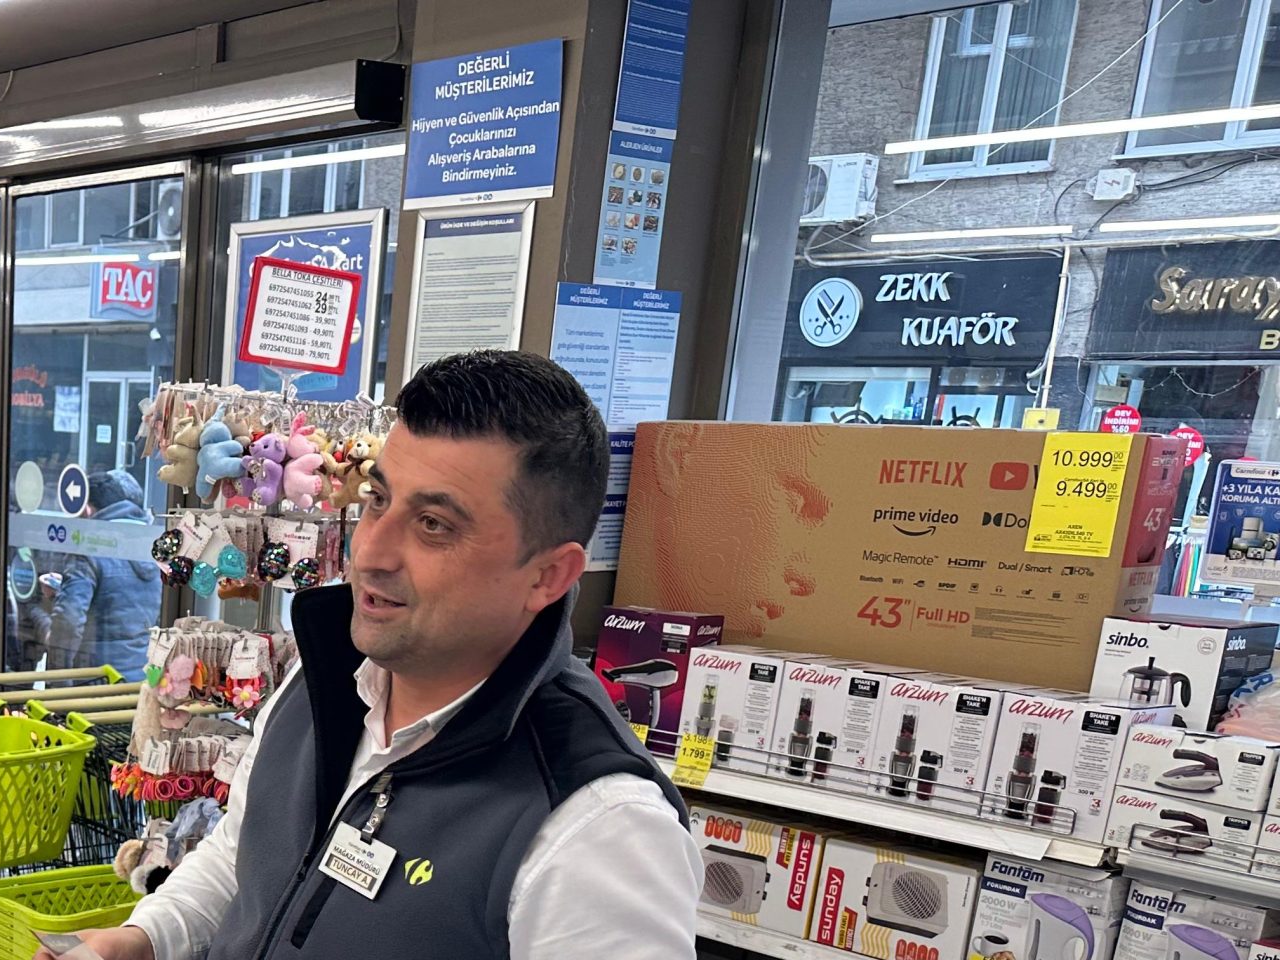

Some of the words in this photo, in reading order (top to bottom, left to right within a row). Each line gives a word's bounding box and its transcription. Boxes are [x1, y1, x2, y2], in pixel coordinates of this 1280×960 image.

[458, 51, 510, 76] DEĞERLİ
[435, 68, 534, 100] MÜŞTERİLERİMİZ
[412, 117, 443, 134] Hijyen
[445, 116, 457, 126] ve
[459, 107, 504, 125] Güvenlik
[505, 100, 560, 121] Açısından
[449, 127, 517, 148] Çocuklarınızı
[428, 150, 471, 167] Alışveriş
[473, 144, 536, 161] Arabalarına
[442, 163, 517, 182] Bindirmeyiniz.
[272, 268, 292, 279] BELLA
[294, 271, 311, 282] TOKA
[103, 267, 153, 308] TAÇ
[875, 272, 953, 302] ZEKK
[315, 291, 327, 303] 24
[315, 303, 327, 314] 29
[901, 312, 1019, 347] KUAFÖR
[1052, 450, 1113, 468] 10.999
[879, 460, 968, 488] NETFLIX
[1056, 480, 1107, 498] 9.499
[1222, 484, 1235, 493] +3
[1238, 484, 1262, 495] YILA
[1221, 494, 1259, 504] KORUMA
[873, 507, 915, 522] prime
[919, 509, 959, 524] video
[862, 550, 892, 564] Magic
[998, 562, 1017, 572] Dual
[1025, 563, 1053, 574] Smart
[604, 615, 645, 634] arzum
[916, 607, 943, 622] Full
[947, 609, 970, 624] HD
[697, 625, 721, 636] arzum
[693, 654, 741, 674] arzum
[789, 667, 842, 690] arzum
[891, 683, 949, 706] arzum
[966, 700, 981, 708] TAKE
[1009, 699, 1074, 724] arzum
[1093, 718, 1109, 726] TAKE
[1132, 732, 1173, 748] arzum
[682, 747, 705, 760] 1.799
[1092, 799, 1101, 808] 3
[1116, 795, 1158, 811] arzum
[332, 860, 361, 880] TUNCAY
[790, 839, 811, 905] sunday
[822, 873, 842, 941] sunday
[981, 895, 1006, 907] 2000
[1008, 901, 1018, 910] W
